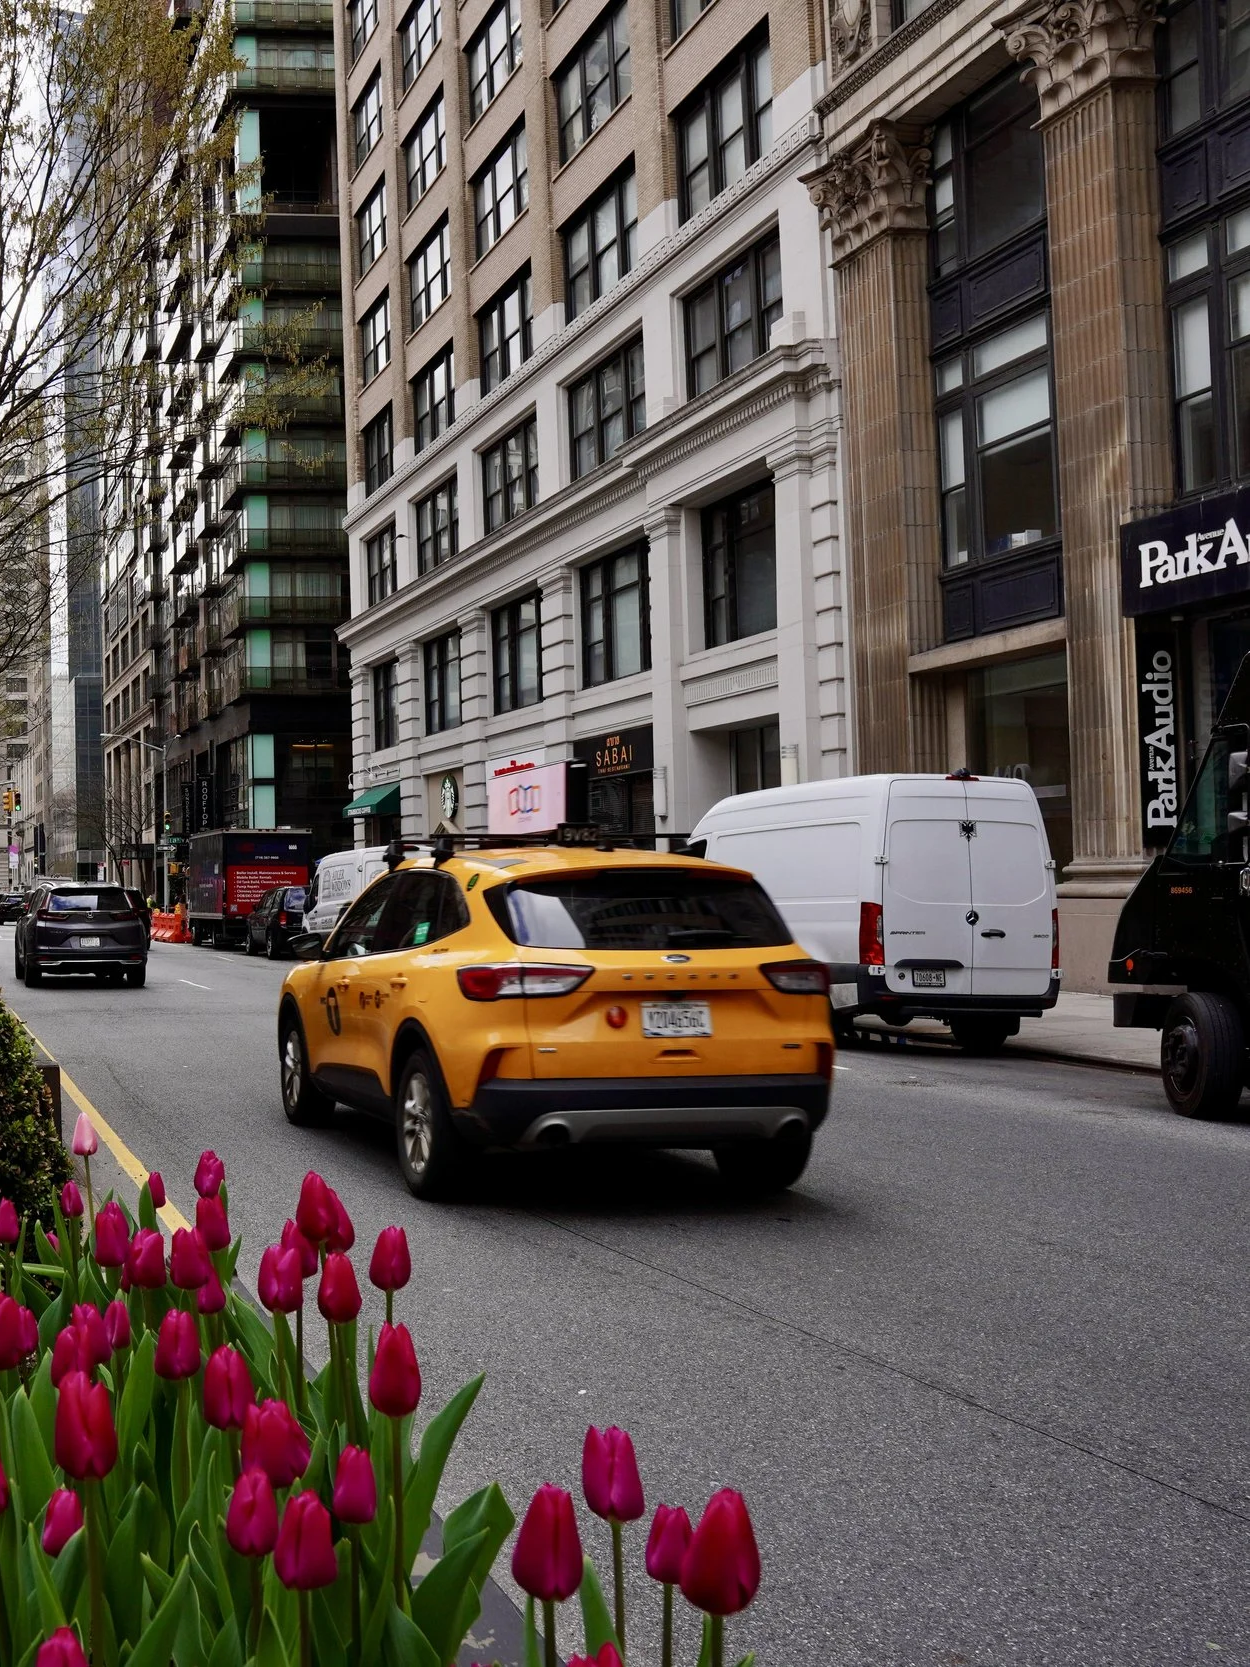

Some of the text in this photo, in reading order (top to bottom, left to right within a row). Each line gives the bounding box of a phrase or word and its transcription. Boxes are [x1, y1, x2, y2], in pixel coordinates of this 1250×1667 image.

[1138, 517, 1250, 588] ParkA
[1197, 527, 1225, 541] Avenue
[596, 744, 632, 767] SABAI
[1141, 650, 1177, 829] ParkAudio
